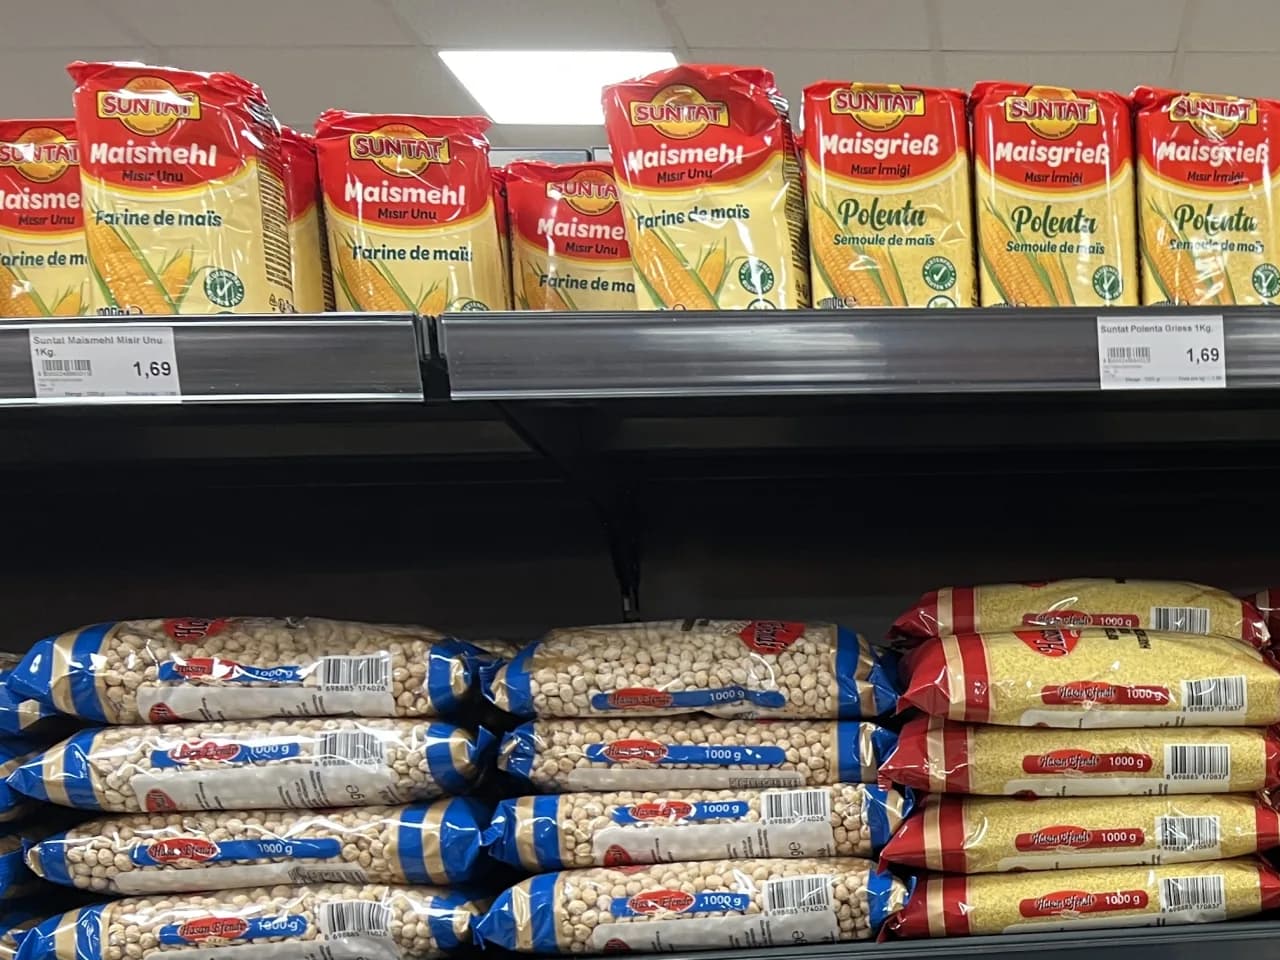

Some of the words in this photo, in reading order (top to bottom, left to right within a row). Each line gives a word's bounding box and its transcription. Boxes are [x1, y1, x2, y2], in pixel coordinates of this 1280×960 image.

[836, 92, 918, 112] SUNTAT
[1011, 100, 1091, 121] SUNTAT
[634, 104, 723, 124] SUNTAT
[90, 140, 217, 166] Maismehl
[353, 136, 445, 160] SUNTAT
[822, 132, 939, 159] Maisgrieß
[628, 143, 745, 171] Maismehl
[995, 142, 1110, 169] Maisgrieß
[344, 183, 466, 206] Maismehl
[96, 208, 150, 225] Farine
[154, 210, 175, 226] de
[179, 211, 222, 226] maïs
[413, 209, 437, 220] Unu
[838, 198, 926, 231] Polenta
[1012, 205, 1097, 238] Polenta
[833, 234, 886, 246] Semoule
[888, 234, 904, 245] de
[906, 234, 935, 245] maïs
[1006, 241, 1057, 253] Semoule
[1060, 242, 1076, 253] de
[1079, 242, 1105, 254] maïs
[352, 246, 406, 260] Farine
[409, 246, 429, 260] de
[432, 245, 473, 263] maïs
[1187, 348, 1219, 364] 1,69
[133, 361, 171, 378] 1,69
[705, 750, 731, 759] 1000
[734, 752, 741, 761] g
[1109, 757, 1134, 766] 1000
[1137, 758, 1144, 768] g
[703, 805, 729, 813] 1000
[732, 806, 739, 814] g
[1101, 833, 1126, 842] 1000
[1130, 834, 1137, 843] g
